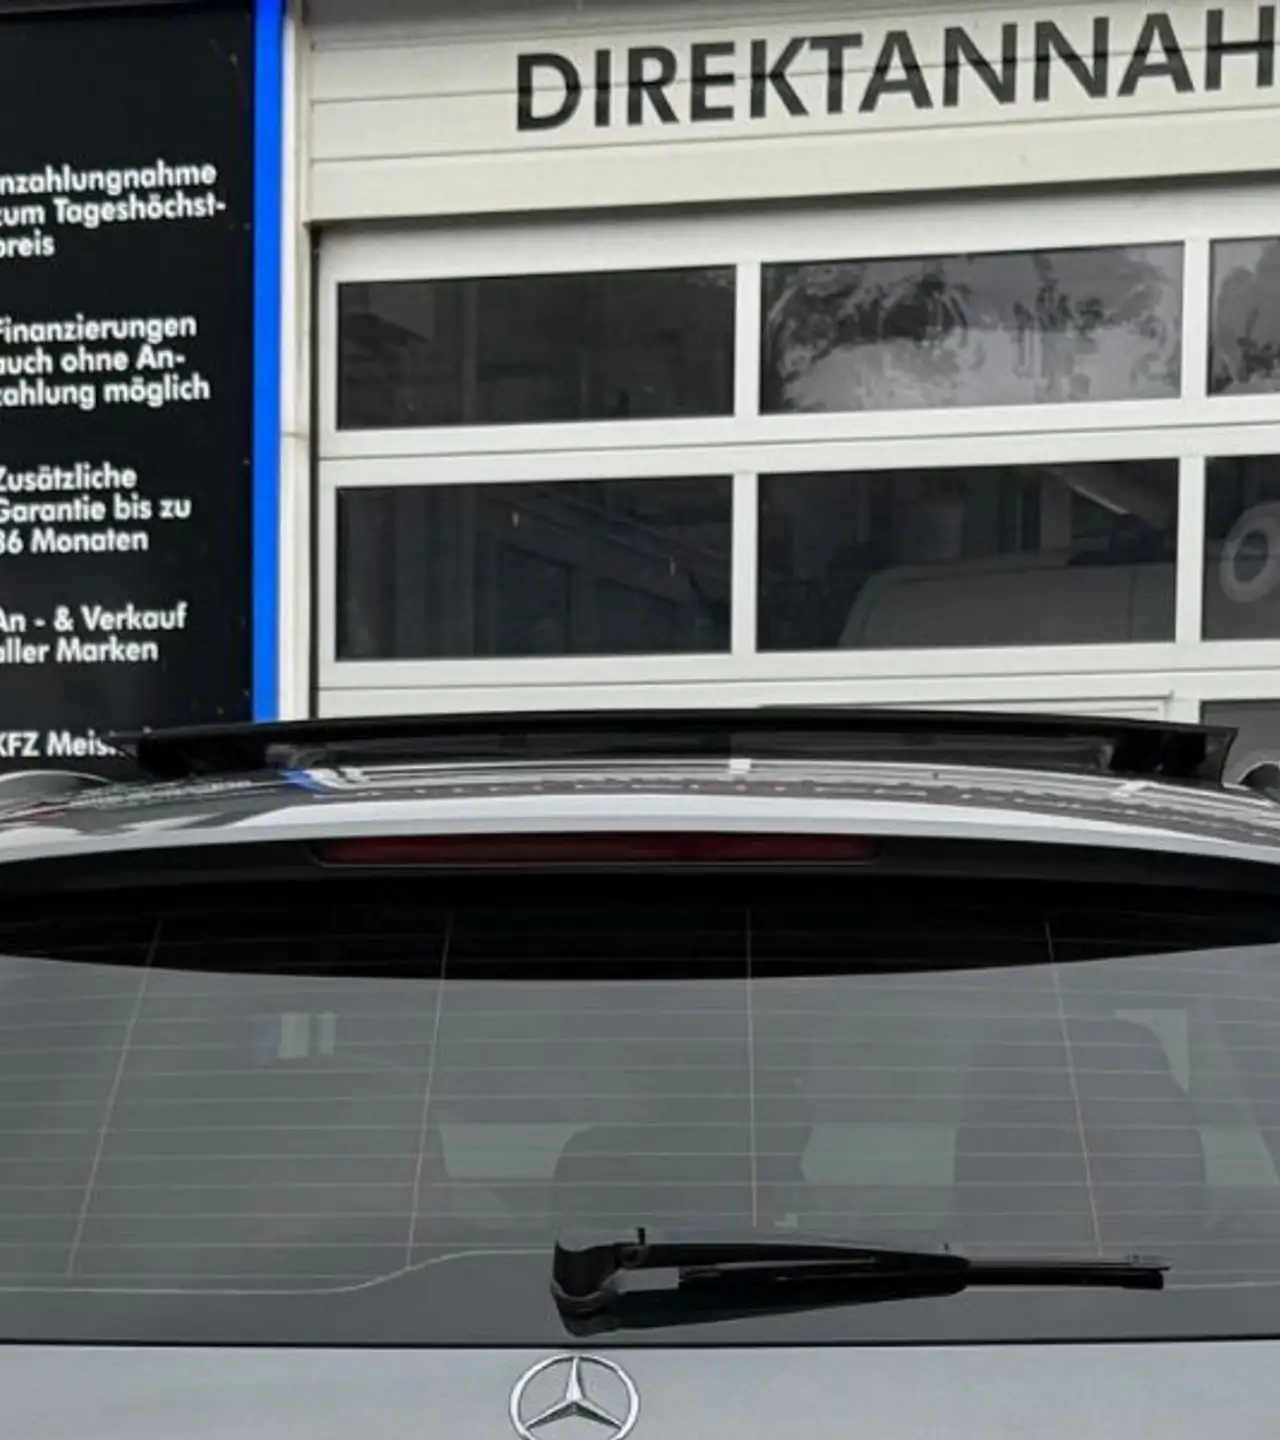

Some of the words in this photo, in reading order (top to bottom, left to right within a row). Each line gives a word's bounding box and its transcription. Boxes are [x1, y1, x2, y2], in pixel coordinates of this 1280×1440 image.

[53, 191, 227, 229] Tageshöchst-
[60, 345, 129, 373] ohne
[136, 344, 186, 370] An-
[103, 373, 211, 408] möglich
[113, 493, 153, 521] bis
[159, 498, 193, 520] zu
[30, 529, 149, 554] Monaten
[54, 605, 75, 632] &
[80, 601, 188, 631] Verkauf
[56, 637, 160, 663] Marken
